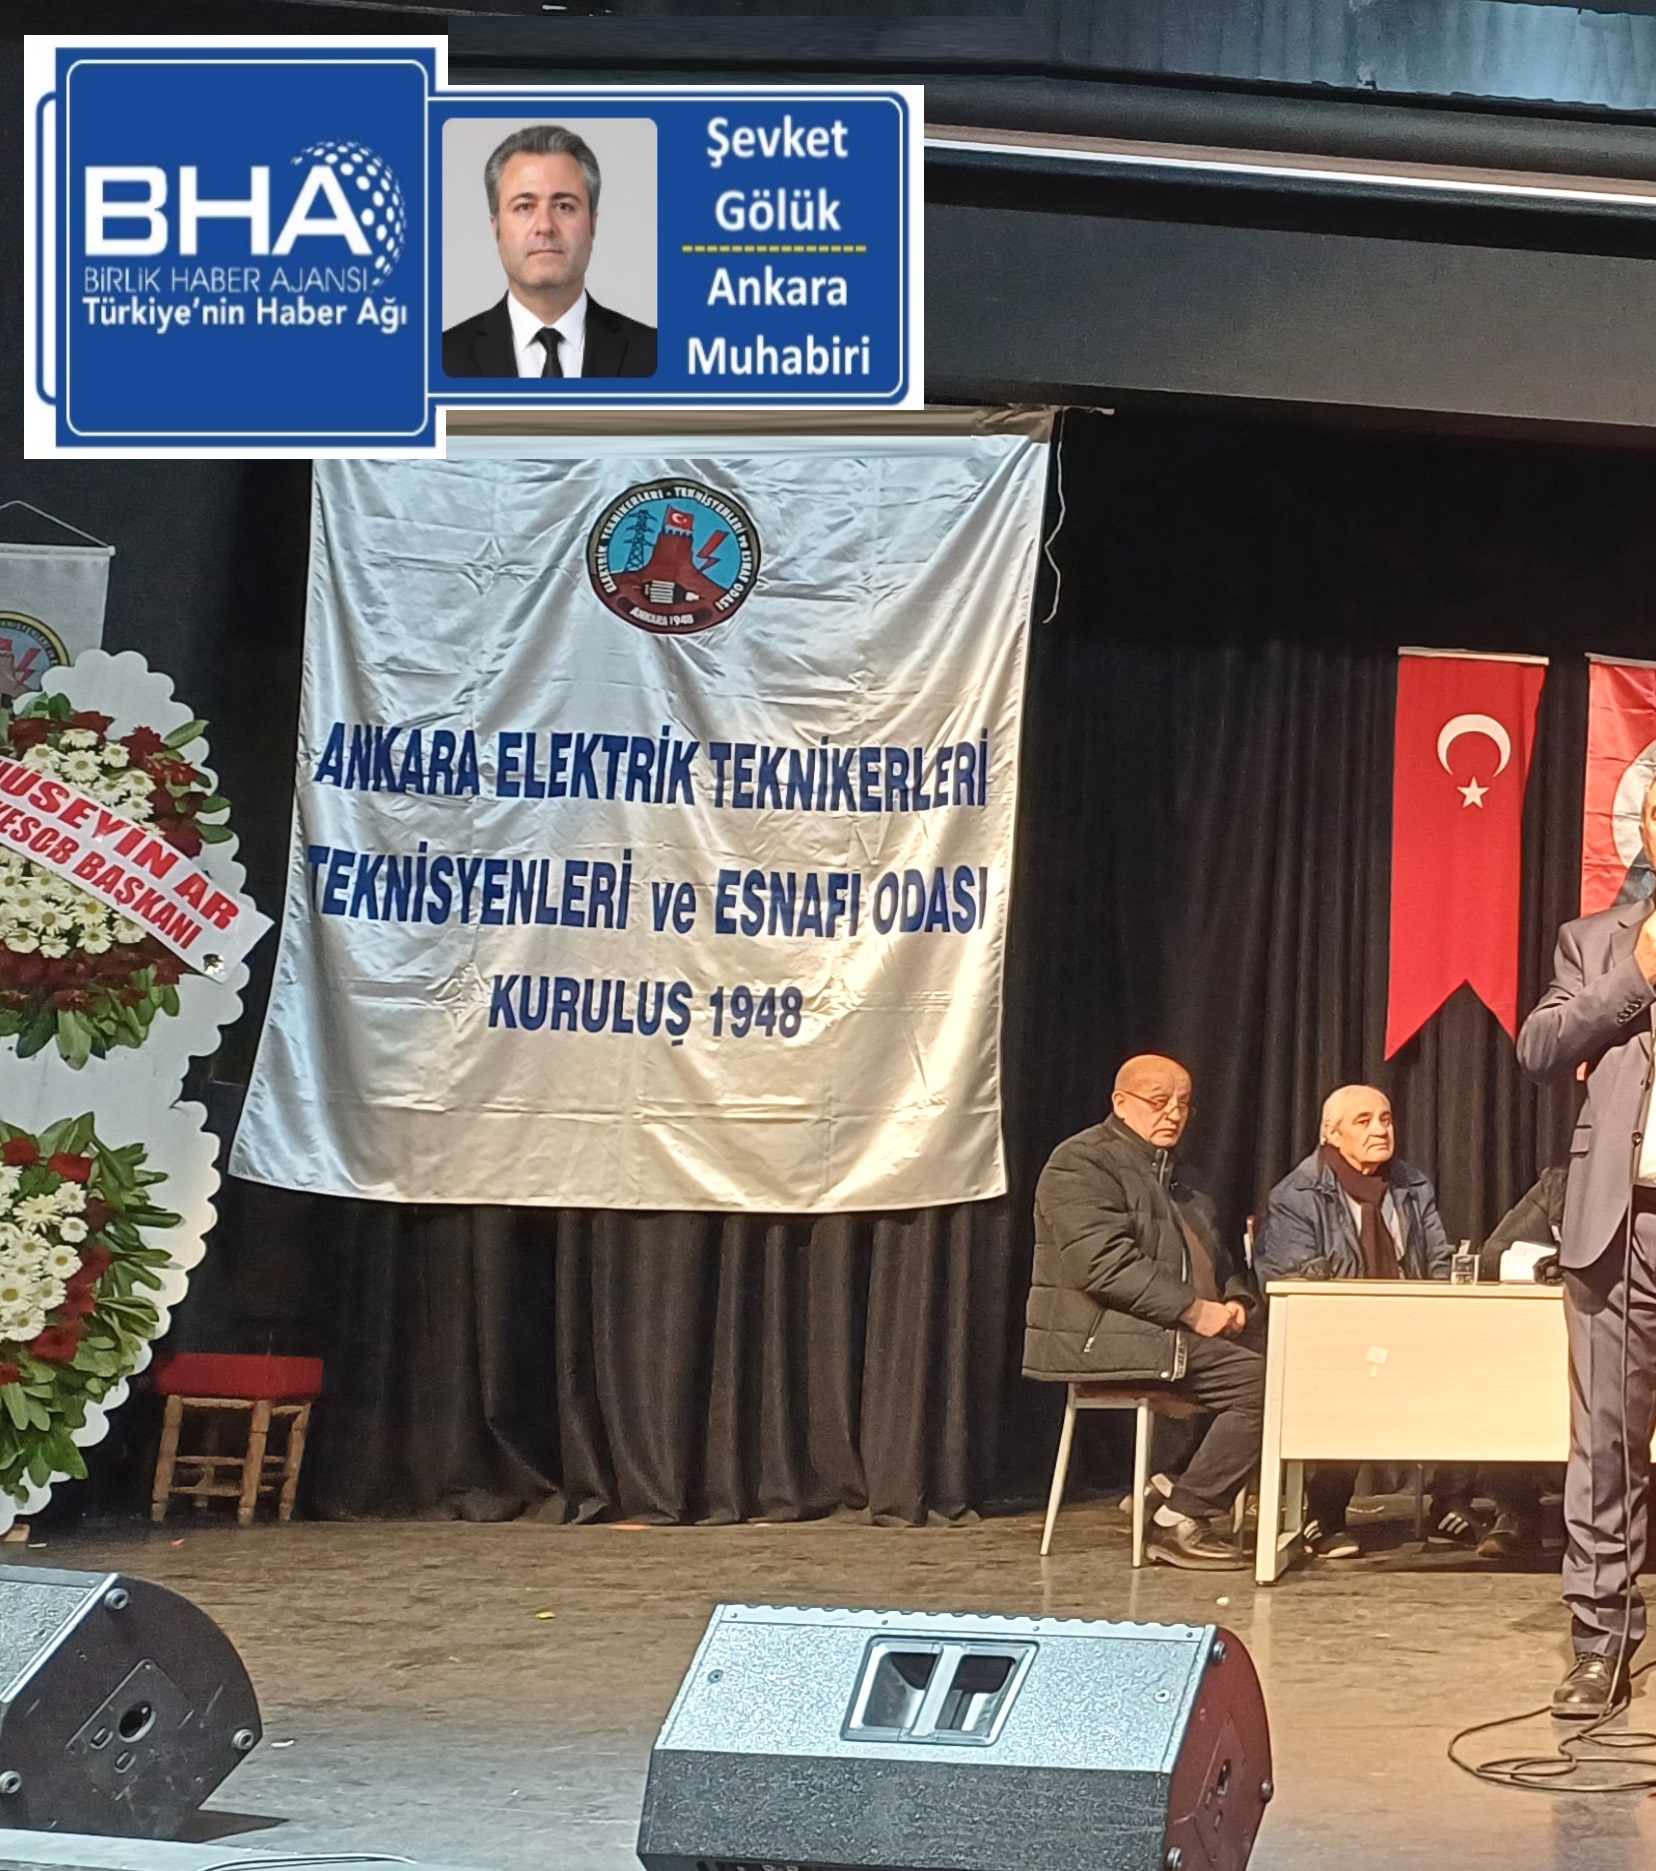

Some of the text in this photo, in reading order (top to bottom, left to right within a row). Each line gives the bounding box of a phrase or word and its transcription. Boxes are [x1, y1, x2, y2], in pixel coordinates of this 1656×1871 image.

[629, 606, 668, 627] ANKARA
[714, 583, 744, 611] ODASI
[312, 722, 988, 812] ANKARA ELEKTRİK TEKNİKERLERİ
[72, 850, 203, 950] BAŞKANI
[172, 872, 240, 930] AR
[308, 841, 989, 938] TEKNİSYENLERİ ve ESNAFI ODASI
[488, 974, 804, 1046] KURULUŞ 1948
